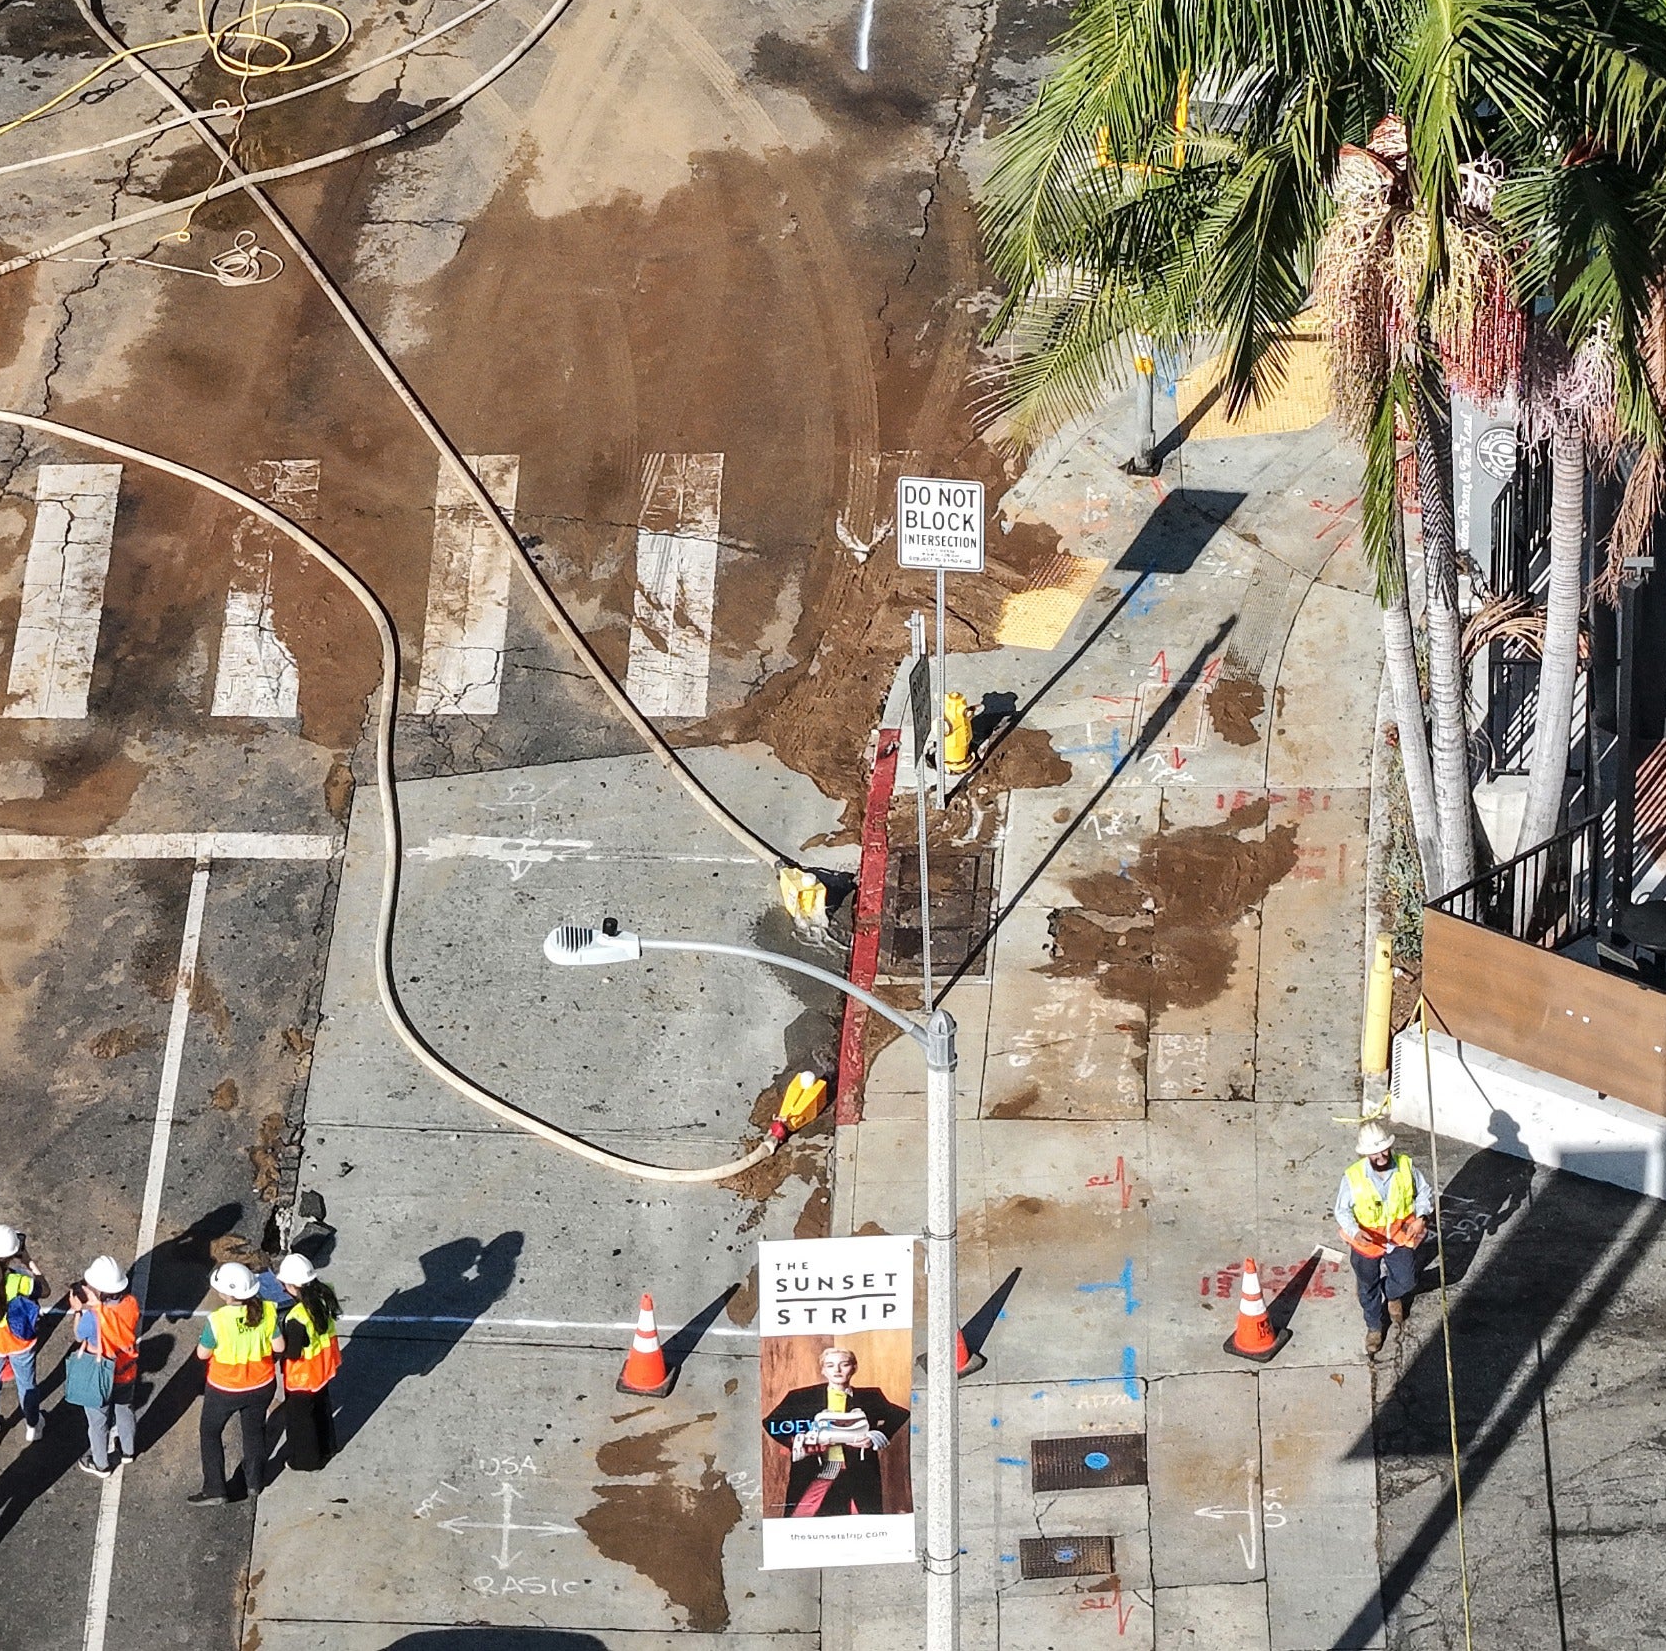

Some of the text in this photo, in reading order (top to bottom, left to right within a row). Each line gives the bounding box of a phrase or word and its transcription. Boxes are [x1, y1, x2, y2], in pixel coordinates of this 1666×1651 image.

[904, 485, 978, 509] DO NOT
[905, 509, 975, 533] BLOCK
[904, 533, 977, 549] INTERSECTION
[775, 1261, 809, 1271] THE
[775, 1272, 898, 1293] SUNSET
[777, 1303, 897, 1325] STRIP
[1262, 1486, 1288, 1529] USA
[790, 1530, 889, 1542] thesunsetstrip.com
